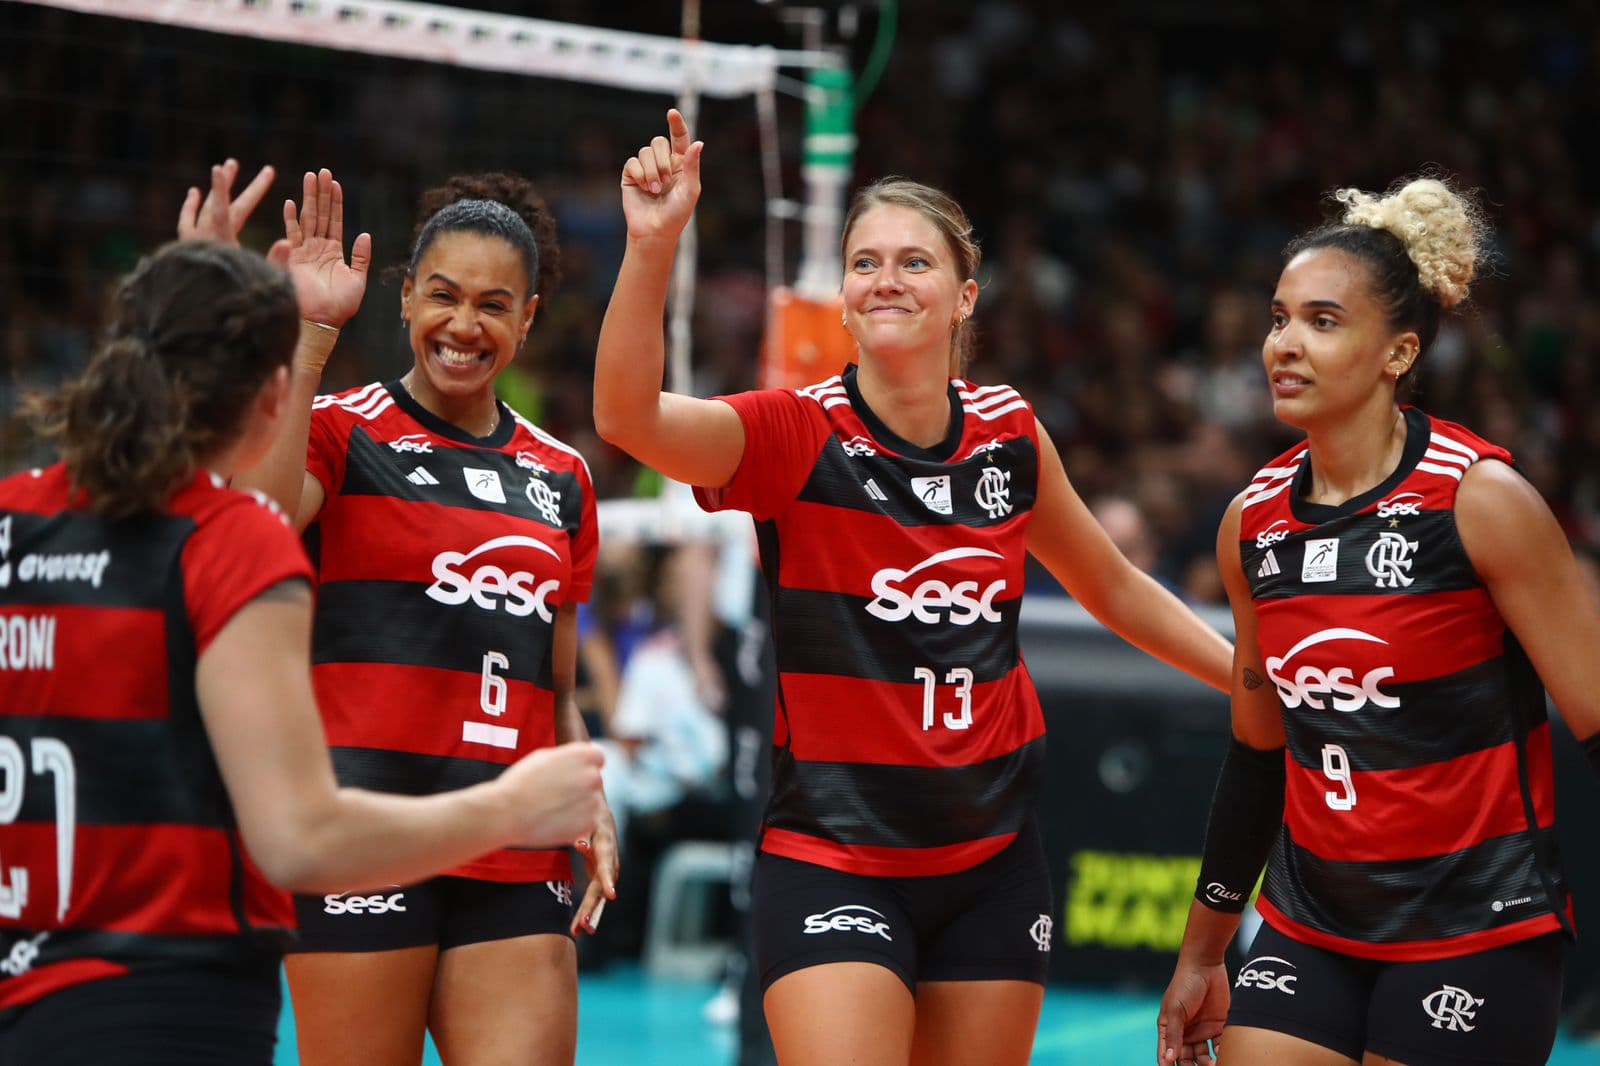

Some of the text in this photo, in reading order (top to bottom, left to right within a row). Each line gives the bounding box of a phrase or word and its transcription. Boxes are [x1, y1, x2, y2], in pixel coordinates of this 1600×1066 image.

[842, 436, 876, 457] Ses
[1377, 492, 1424, 518] Sesc
[425, 535, 561, 624] Sesc
[865, 547, 1006, 626] Sesc
[480, 650, 509, 717] 6
[914, 667, 974, 731] 13
[1265, 628, 1400, 712] Sesc
[1321, 743, 1357, 811] 9
[324, 885, 406, 915] Sesc
[803, 905, 892, 941] Sesc
